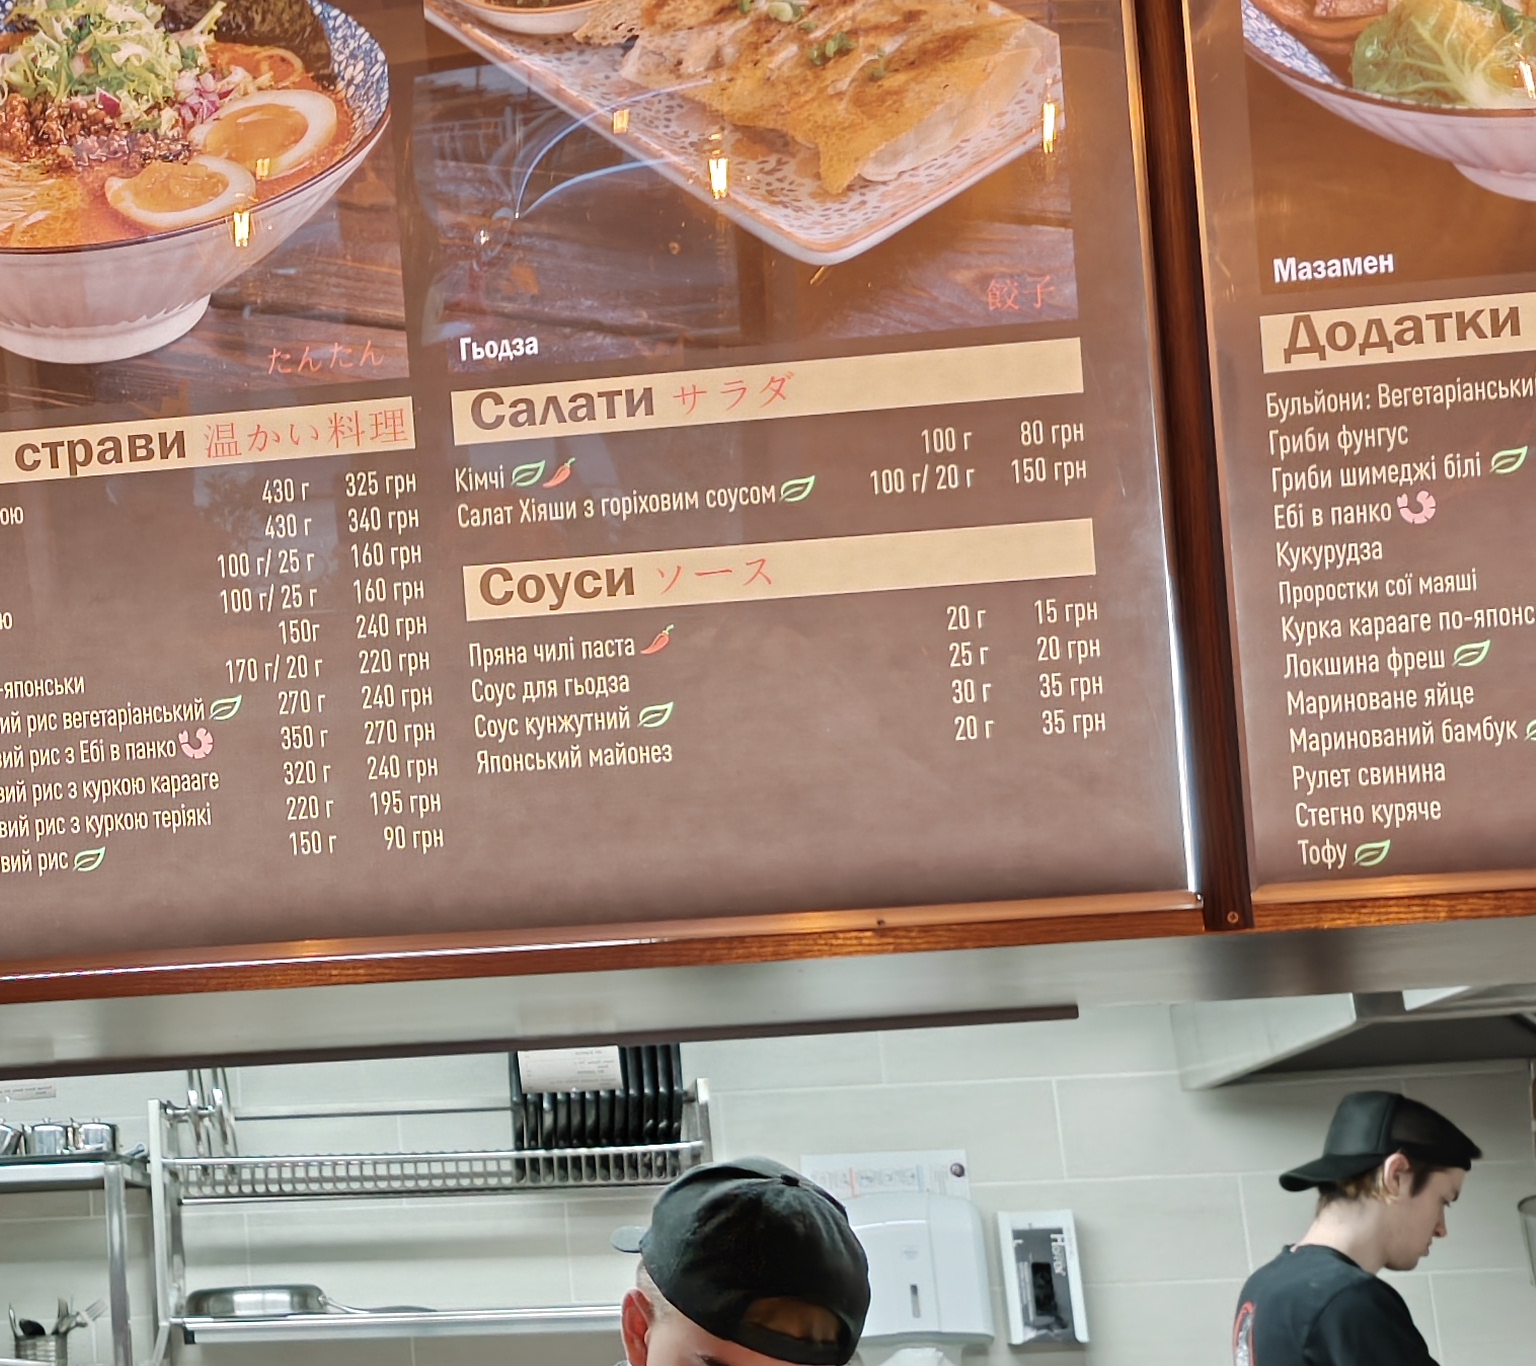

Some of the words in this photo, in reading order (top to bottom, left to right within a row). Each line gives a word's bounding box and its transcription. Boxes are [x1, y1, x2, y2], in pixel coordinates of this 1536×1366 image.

[1273, 253, 1394, 283] Мазамен
[459, 336, 539, 362] Гьодза
[1283, 306, 1521, 365] Додатки
[470, 387, 654, 431] Салати
[1266, 389, 1371, 423] Бульйони:
[1377, 377, 1536, 410] Вегетаріанськи
[921, 427, 956, 454] 100
[963, 431, 972, 450] г
[1020, 420, 1044, 446] 80
[1051, 423, 1084, 449] грн
[14, 430, 186, 477] страви
[262, 478, 295, 504] 430
[301, 482, 310, 501] г
[345, 470, 379, 497] 325
[385, 473, 416, 500] грн
[455, 464, 505, 492] Кімчі
[1271, 464, 1332, 498] Гриби
[1340, 455, 1436, 487] шимеджі
[1444, 451, 1481, 479] білі
[457, 503, 513, 528] Салат
[519, 498, 577, 524] Хіяши
[583, 499, 595, 518] з
[601, 489, 699, 521] горіховим
[705, 485, 776, 513] соусом
[1276, 541, 1383, 573] Кукурудза
[479, 566, 635, 611] Соуси
[1278, 580, 1379, 609] Проростки
[1385, 572, 1413, 597] сої
[1419, 567, 1477, 595] маяші
[278, 619, 320, 645] 150г
[356, 613, 389, 639] 240
[395, 616, 427, 642] грн
[469, 642, 528, 673] Пряна
[533, 636, 575, 662] чилі
[581, 638, 635, 660] паста
[1283, 653, 1380, 679] Локшина
[1387, 646, 1445, 678] фреш
[471, 678, 516, 707] Соус
[522, 679, 558, 704] для
[564, 674, 630, 699] гьодза
[1286, 689, 1417, 719] Мариноване
[1424, 681, 1474, 709] яйце
[26, 713, 58, 738] рис
[62, 697, 205, 733] вегетаріанський
[474, 714, 519, 743] Соус
[525, 705, 630, 741] кунжутний
[1042, 709, 1066, 735] 35
[1072, 712, 1106, 739] грн
[476, 744, 582, 774] Японський
[589, 742, 673, 768] майонез
[32, 782, 63, 807] рис
[67, 781, 78, 799] з
[82, 777, 146, 804] куркою
[150, 772, 219, 799] карааге
[1297, 837, 1347, 870] Тофу
